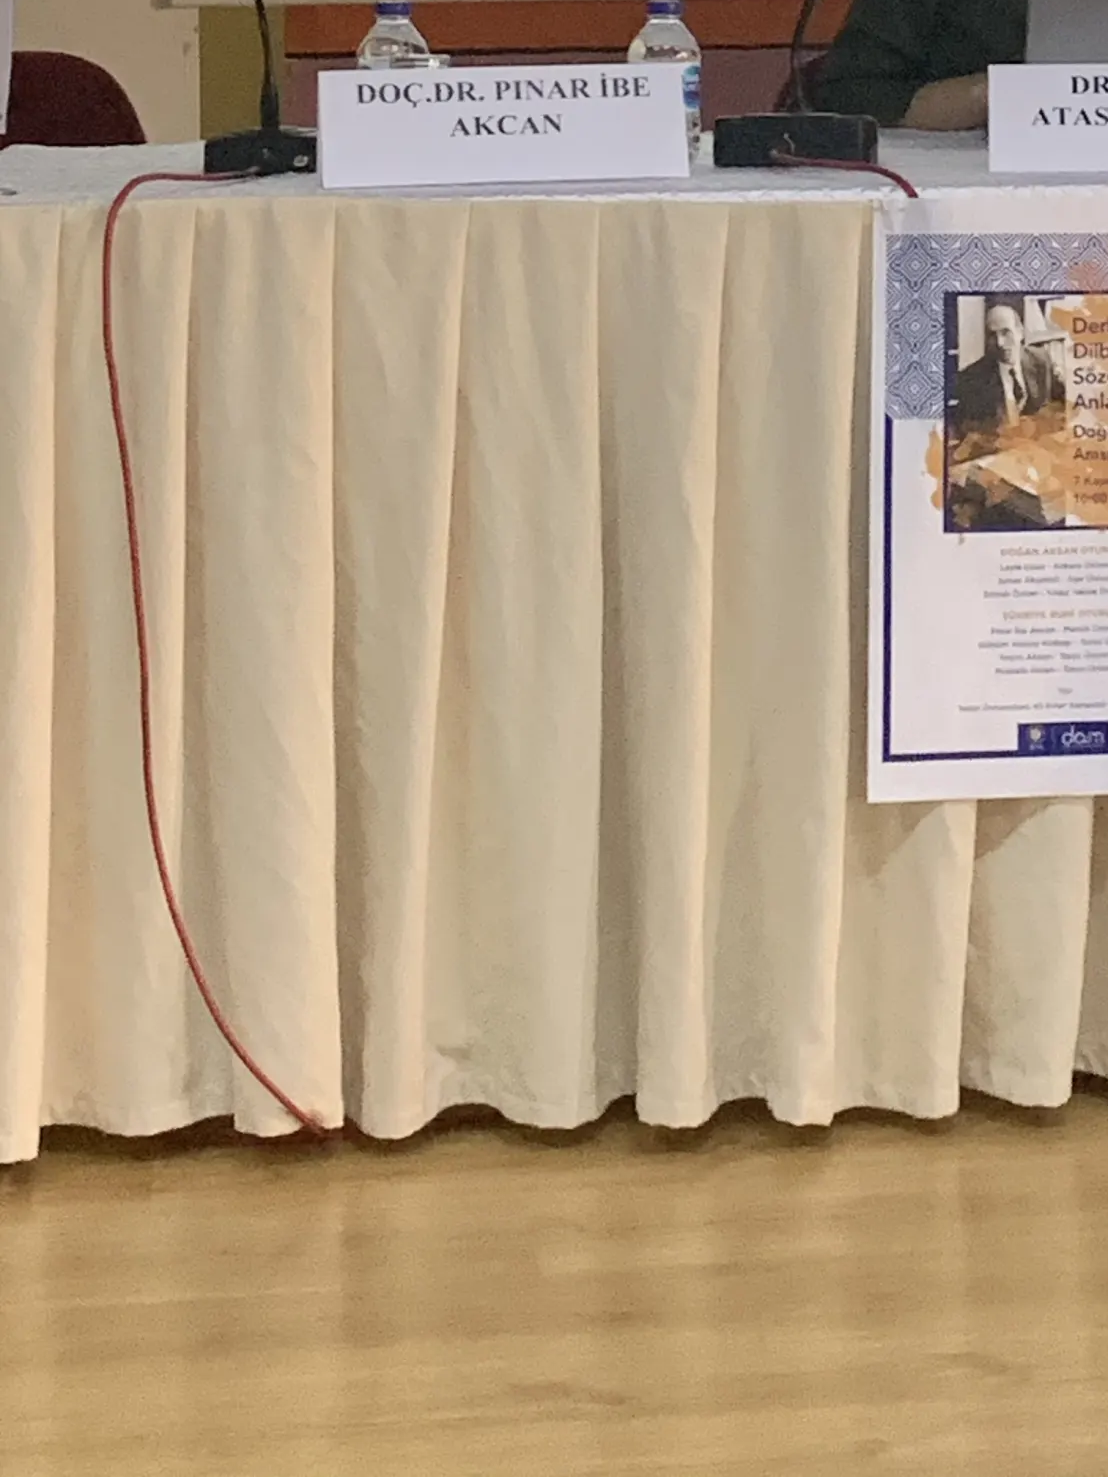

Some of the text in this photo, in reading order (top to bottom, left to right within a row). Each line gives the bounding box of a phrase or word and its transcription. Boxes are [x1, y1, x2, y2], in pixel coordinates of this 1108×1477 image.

[356, 73, 651, 109] DOÇ.DR. PINAR İBE
[449, 114, 563, 138] AKCAN
[1061, 726, 1105, 746] dam
